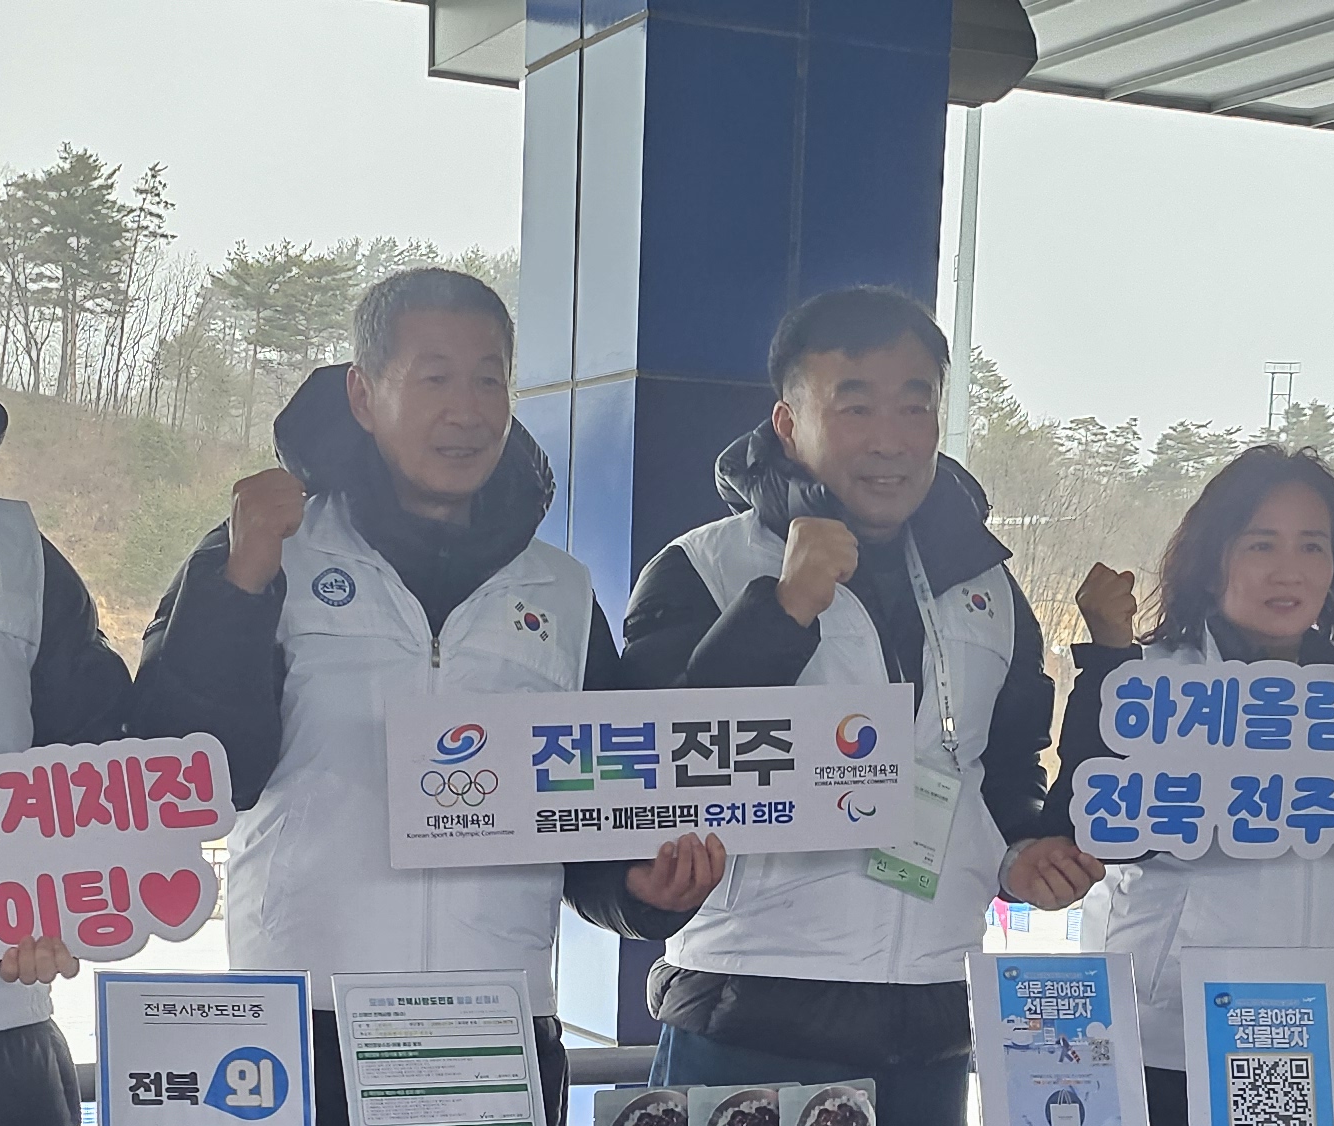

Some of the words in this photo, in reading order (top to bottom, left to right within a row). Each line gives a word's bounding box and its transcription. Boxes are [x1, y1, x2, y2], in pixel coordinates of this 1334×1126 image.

[531, 722, 660, 793] 전북
[672, 718, 795, 787] 전주
[814, 763, 899, 780] 대한장애인체육회
[535, 804, 700, 834] 올림픽·패럴림픽
[703, 802, 747, 827] 유치
[752, 800, 796, 825] 희망
[1084, 772, 1205, 844] 전북
[427, 813, 495, 830] 대한체육회
[430, 831, 448, 839] Sport
[1016, 981, 1042, 997] 설문
[1045, 980, 1097, 997] 참여하고
[144, 1002, 265, 1019] 전북사랑도민증
[1024, 998, 1093, 1019] 선물받자
[1227, 1008, 1255, 1025] 설문
[1258, 1008, 1315, 1025] 참여하고
[1235, 1026, 1309, 1048] 선물받자
[128, 1071, 201, 1106] 전북
[225, 1059, 275, 1109] 외
